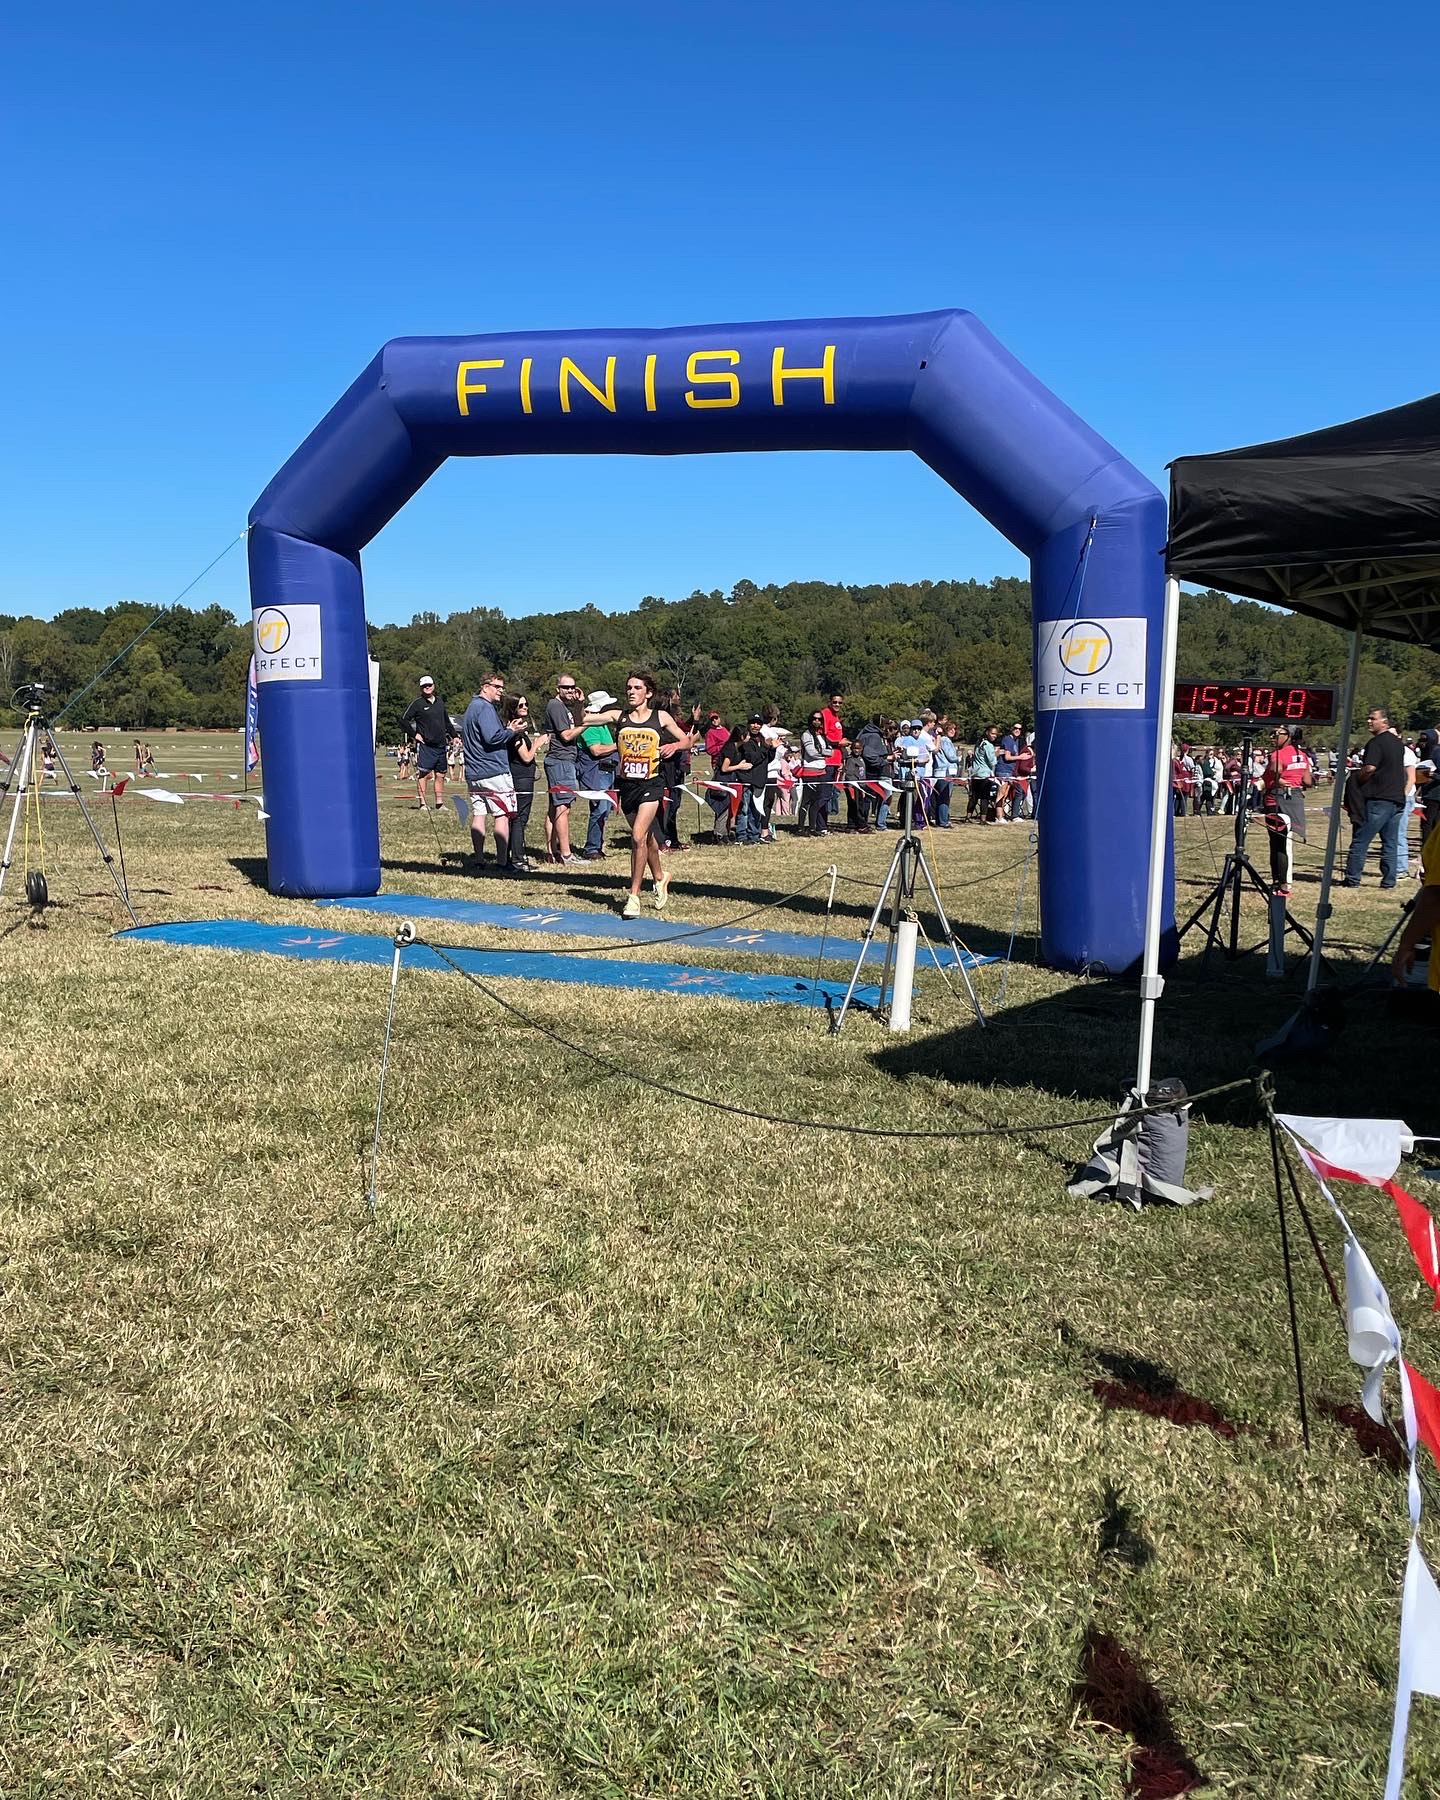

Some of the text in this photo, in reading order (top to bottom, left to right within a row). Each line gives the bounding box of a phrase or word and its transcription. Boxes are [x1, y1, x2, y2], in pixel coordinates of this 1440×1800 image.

[456, 345, 837, 417] FINISH
[259, 620, 288, 651] PT
[256, 657, 320, 672] ERFECT
[1059, 637, 1109, 673] PT
[1039, 682, 1144, 697] PERFECT
[623, 762, 649, 774] 2604
